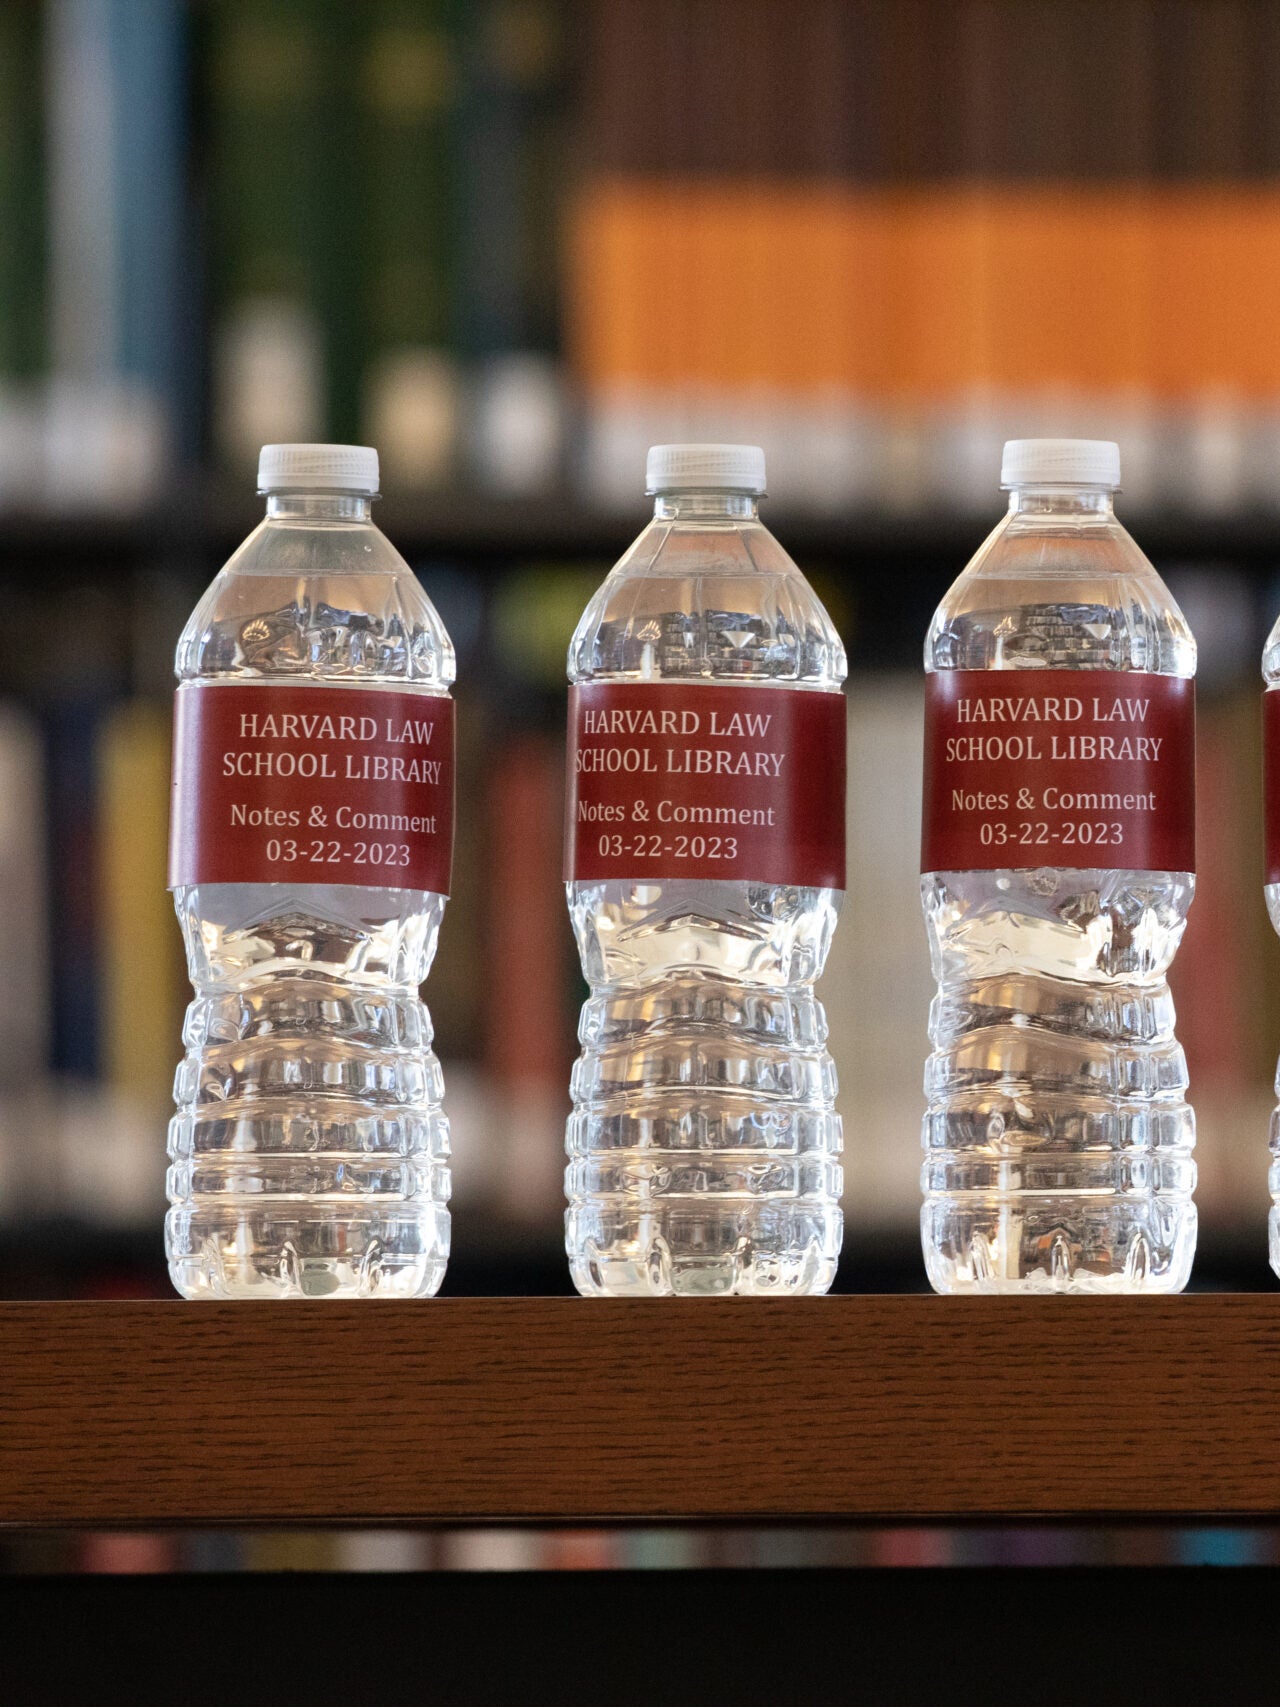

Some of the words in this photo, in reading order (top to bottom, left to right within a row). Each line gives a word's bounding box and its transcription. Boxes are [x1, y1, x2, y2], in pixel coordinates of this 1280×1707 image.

[584, 709, 700, 734] HARVARD
[709, 712, 771, 737] LAW
[957, 698, 1083, 723] HARVARD
[1092, 698, 1150, 722] LAW
[240, 714, 377, 740] HARVARD
[386, 719, 434, 745] LAW
[574, 746, 657, 773] SCHOOL
[666, 749, 785, 777] LIBRARY
[946, 736, 1042, 762] SCHOOL
[1051, 736, 1163, 762] LIBRARY
[223, 752, 336, 777] SCHOOL
[345, 755, 441, 785] LIBRARY
[952, 789, 1009, 811] Notes
[1016, 788, 1036, 809] &
[1043, 788, 1156, 811] Comment
[231, 804, 300, 826] Notes
[308, 805, 328, 827] &
[336, 806, 436, 834] Comment
[577, 800, 625, 821] Notes
[632, 800, 650, 821] &
[657, 800, 775, 826] Comment
[597, 835, 737, 859] 03-22-2023
[979, 823, 1124, 846] 03-22-2023
[266, 840, 410, 866] 03-22-2023
